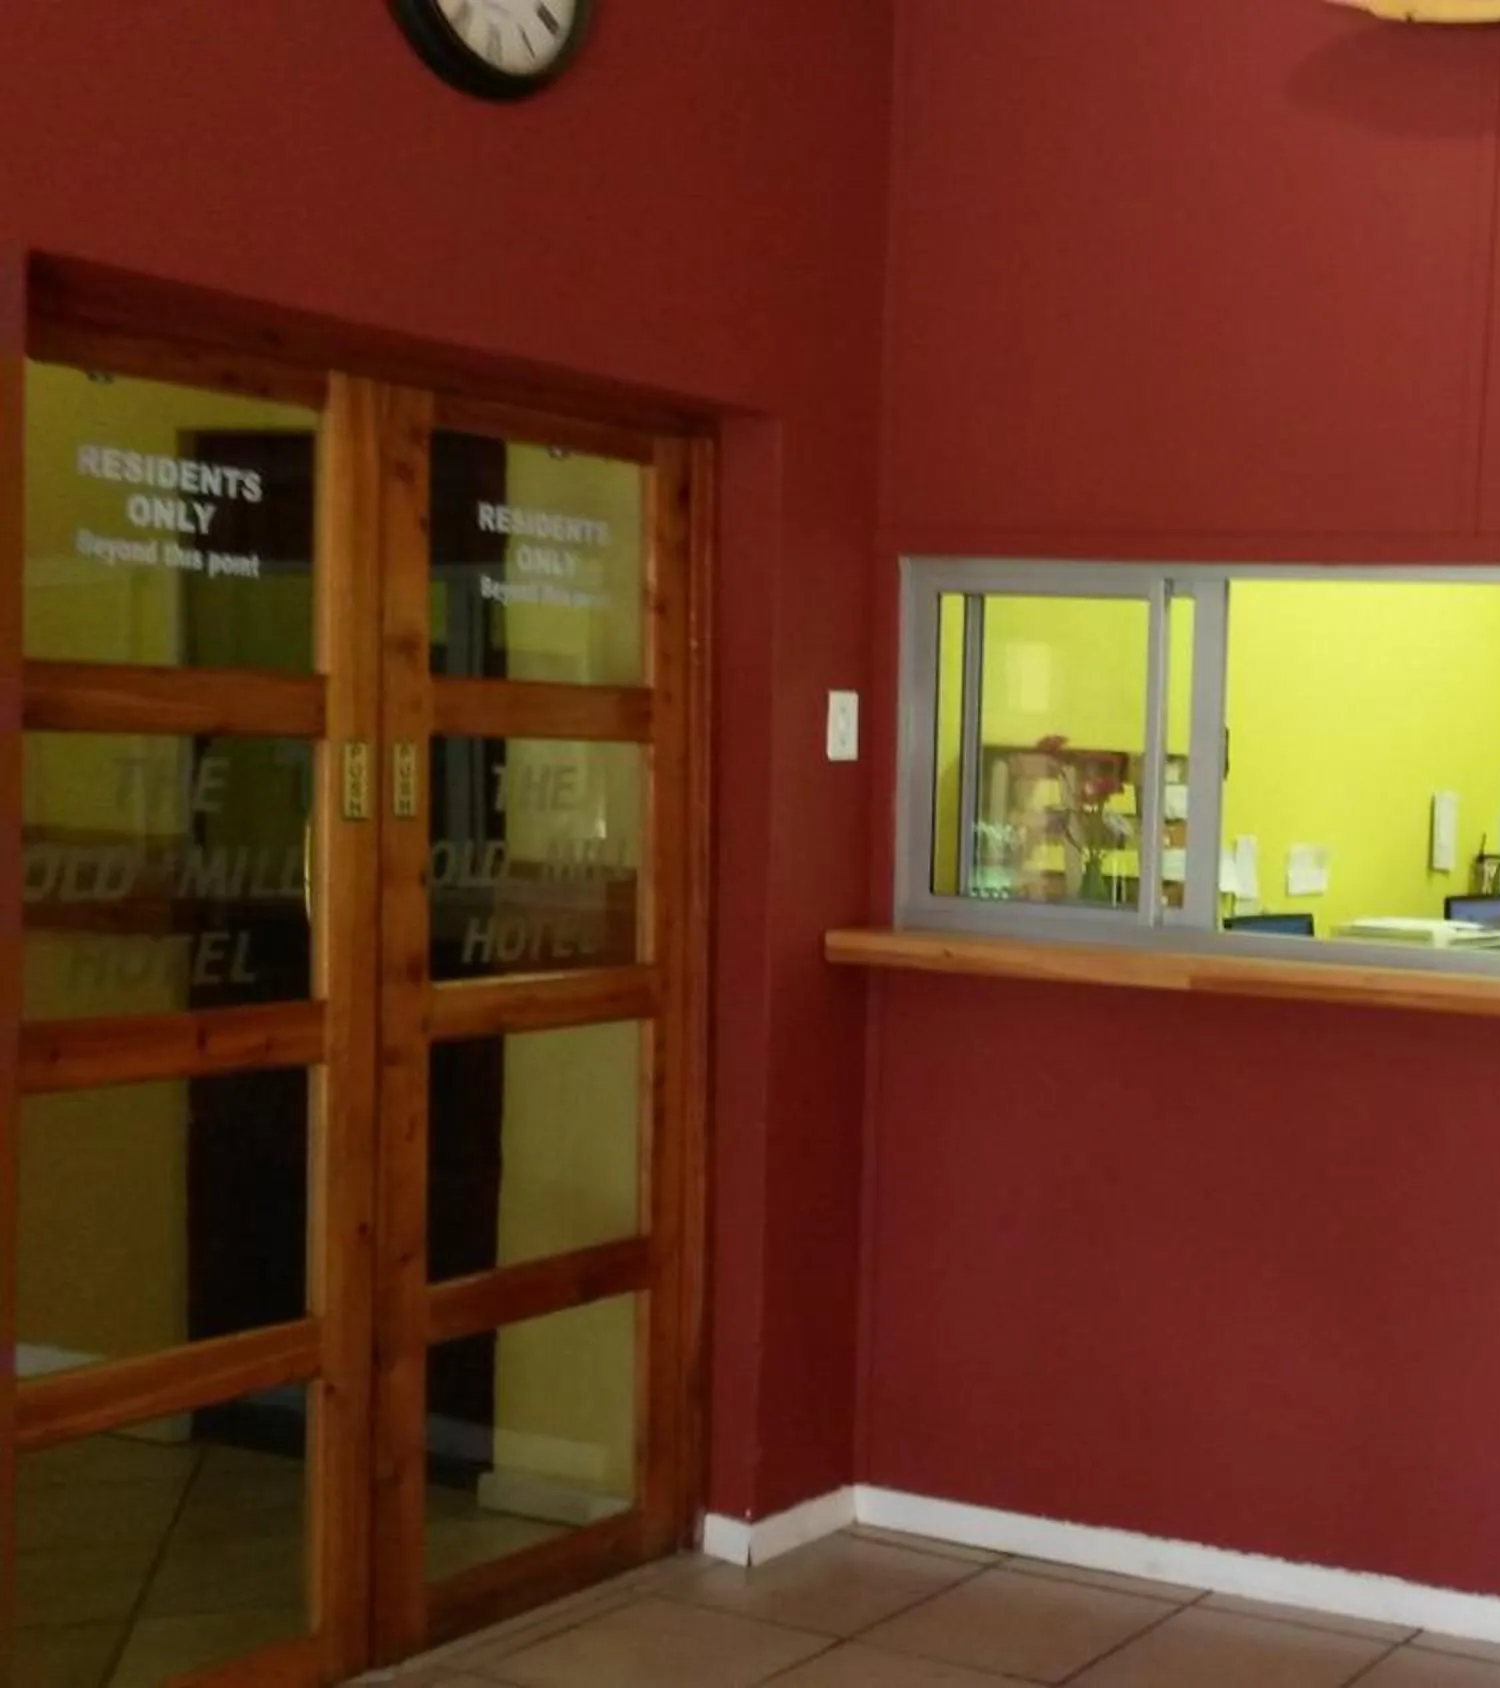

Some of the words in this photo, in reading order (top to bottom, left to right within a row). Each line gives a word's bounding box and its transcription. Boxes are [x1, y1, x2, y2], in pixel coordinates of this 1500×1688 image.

[77, 445, 263, 503] RESIDENTS
[127, 494, 216, 535] ONLY
[478, 502, 611, 546] RESIDENTS
[77, 530, 158, 566] Beyond
[163, 541, 203, 571] this
[516, 544, 580, 578] ONLY
[492, 763, 578, 811] THE
[430, 839, 508, 887] OLD
